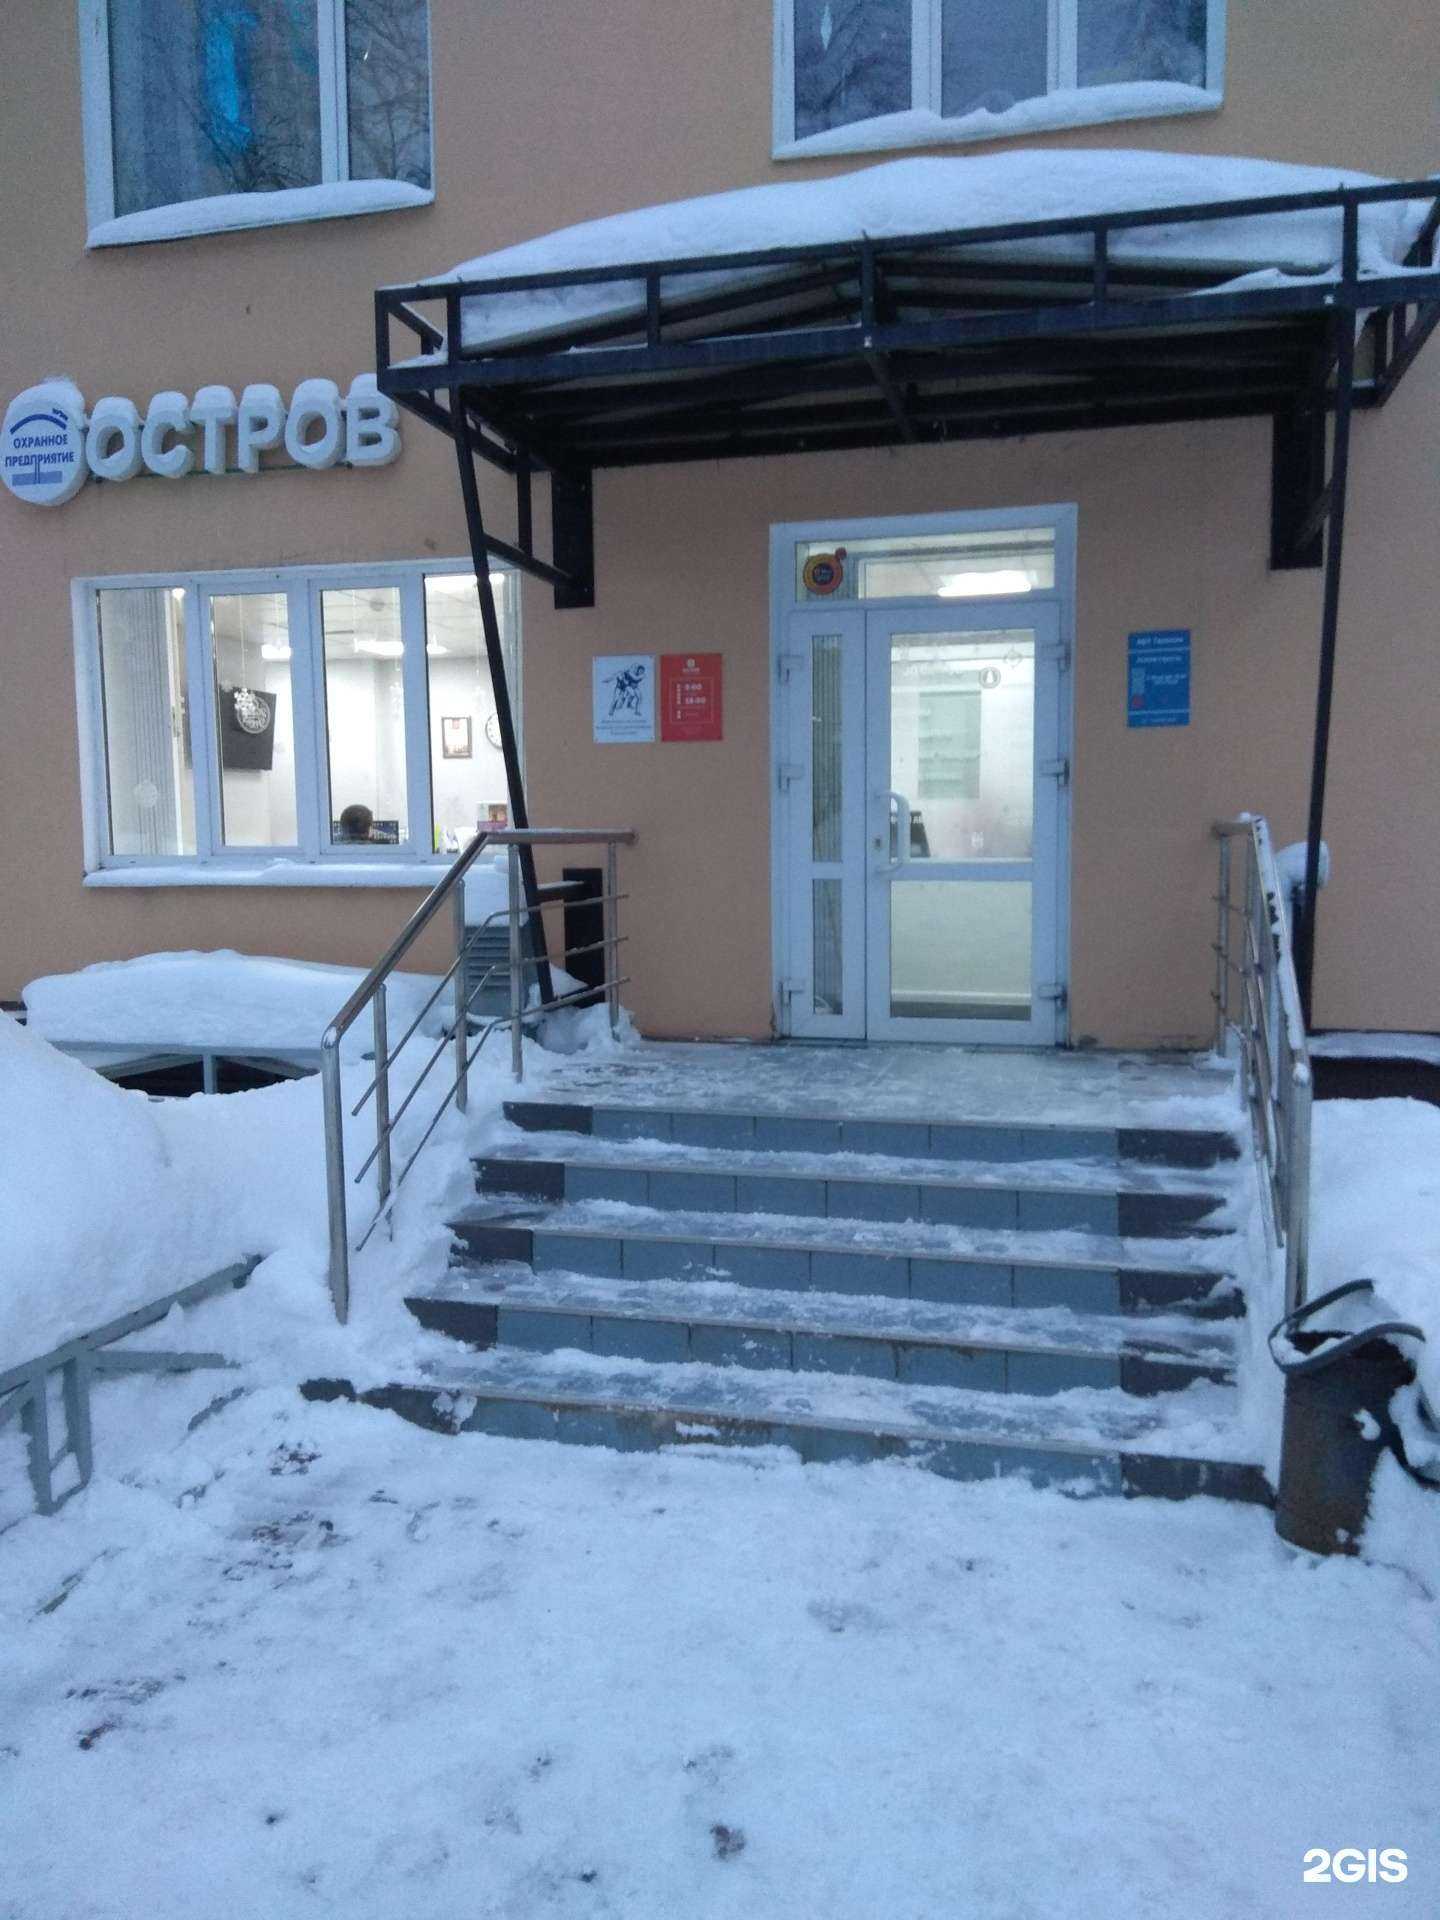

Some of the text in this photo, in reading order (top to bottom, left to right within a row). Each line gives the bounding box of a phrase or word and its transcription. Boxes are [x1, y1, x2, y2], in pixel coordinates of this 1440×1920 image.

[85, 379, 402, 481] ОСТРОВ
[13, 433, 69, 449] ОХРАННОЕ
[5, 450, 75, 467] ПРЕДПРИЯТИЕ
